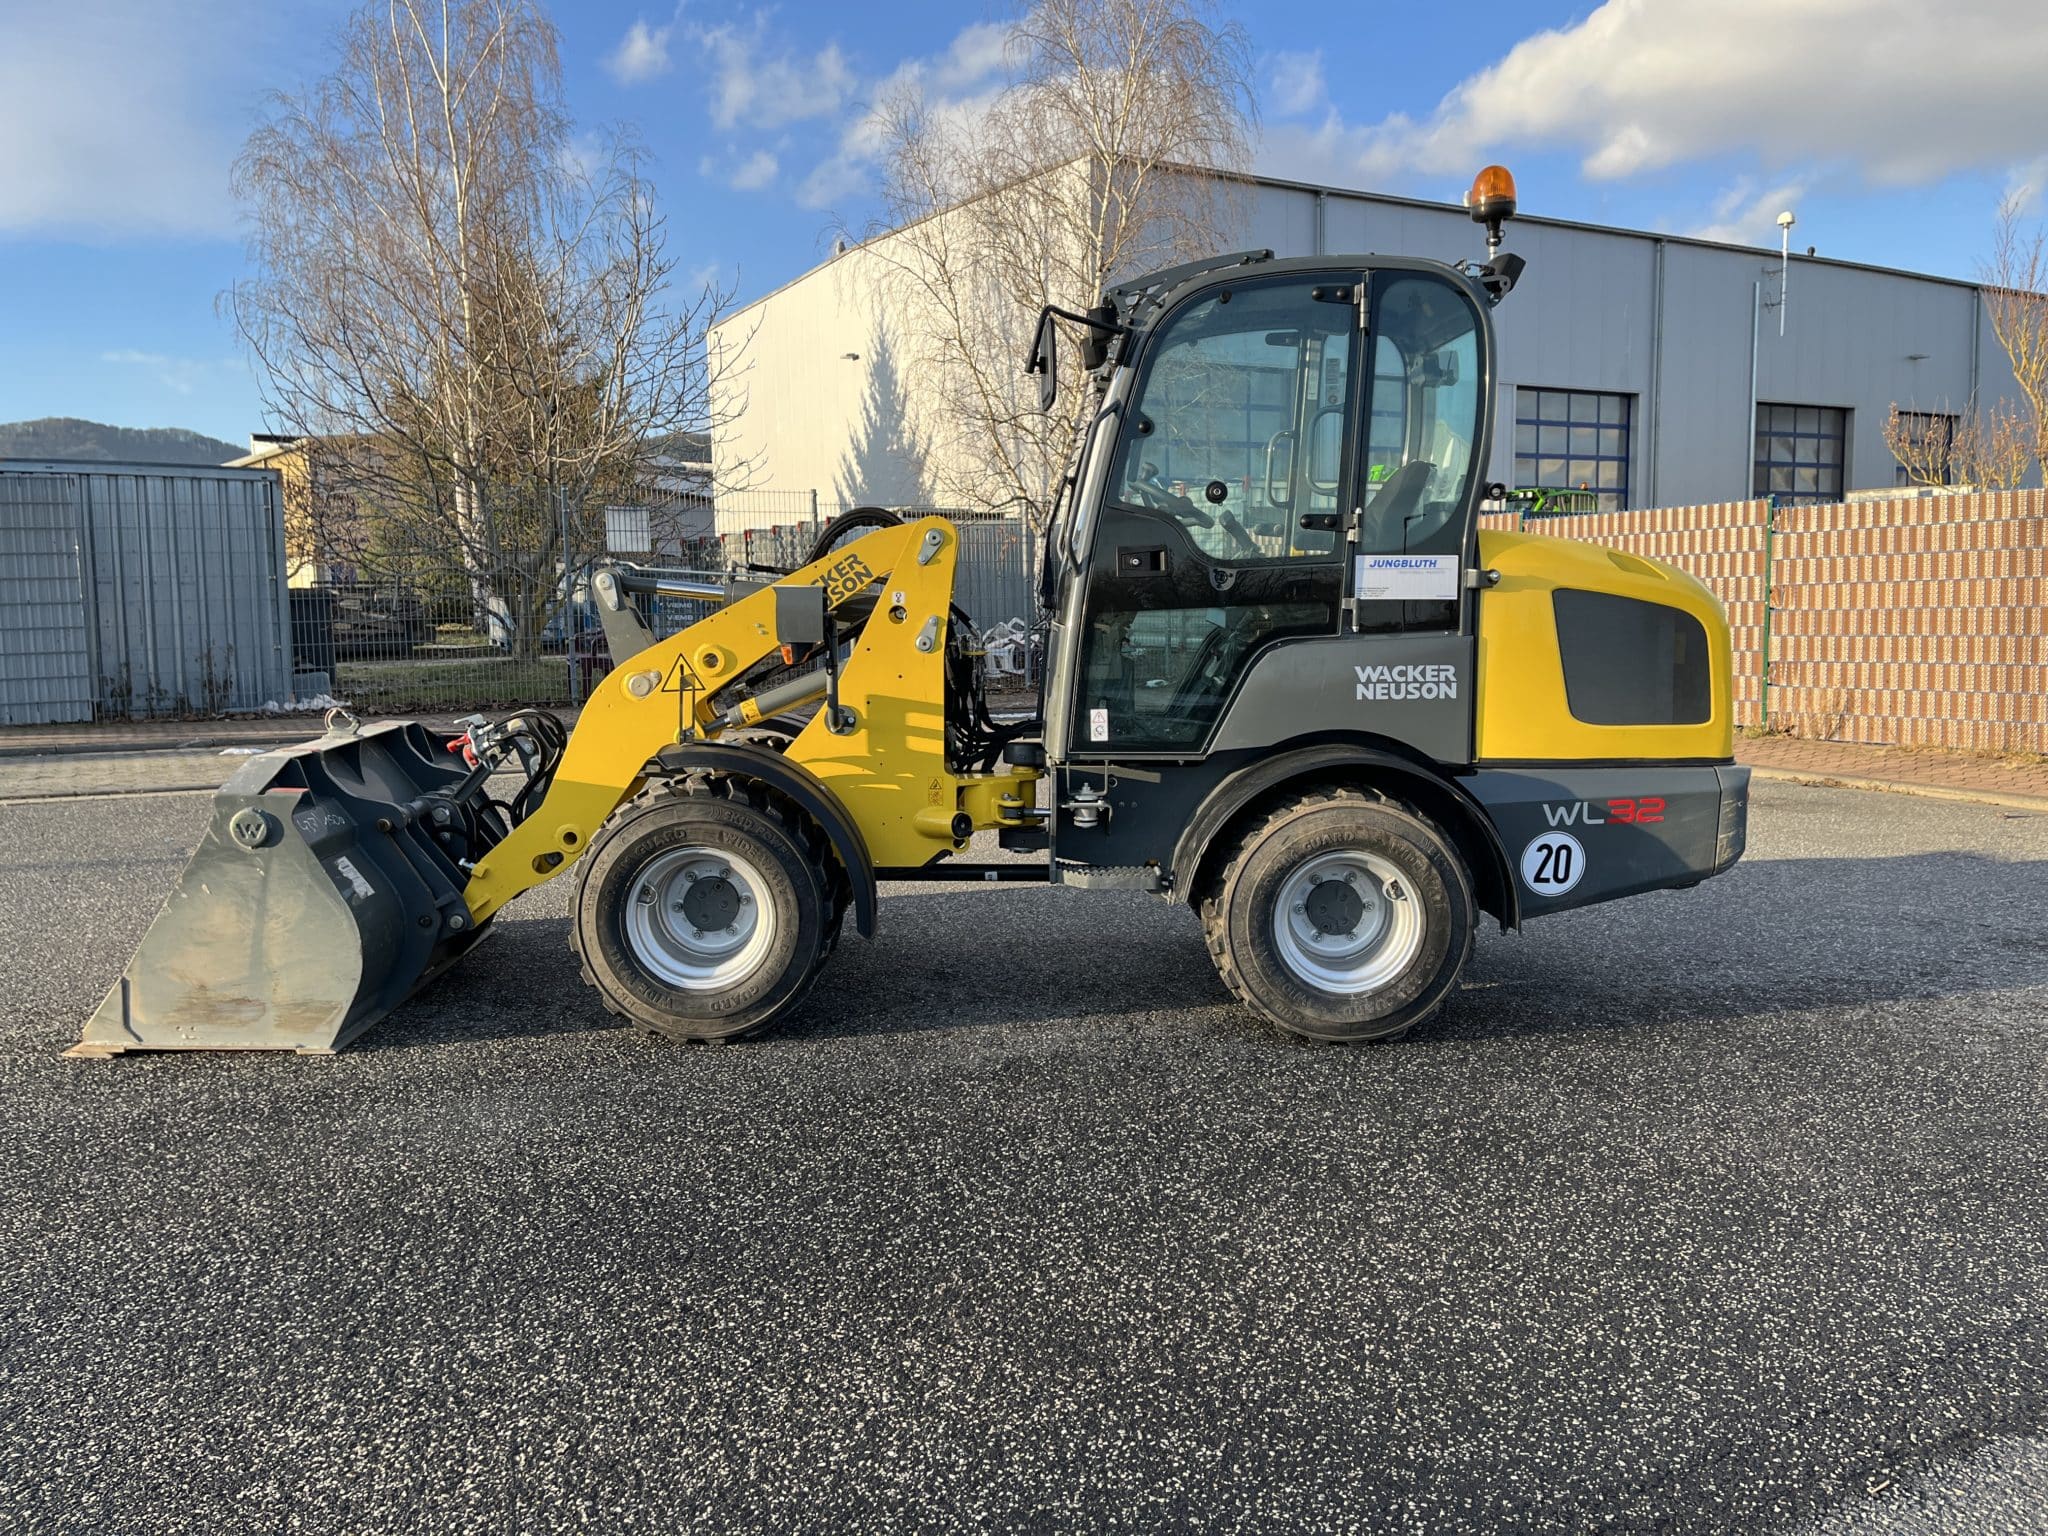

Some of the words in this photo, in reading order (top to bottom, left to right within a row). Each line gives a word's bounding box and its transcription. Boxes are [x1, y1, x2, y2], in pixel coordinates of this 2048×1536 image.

[811, 553, 865, 589] KER
[1369, 559, 1437, 569] JUNGBLUTH
[827, 564, 875, 608] SON
[1354, 664, 1458, 683] WACKER
[1356, 682, 1457, 700] NEUSON
[1533, 843, 1573, 884] 20
